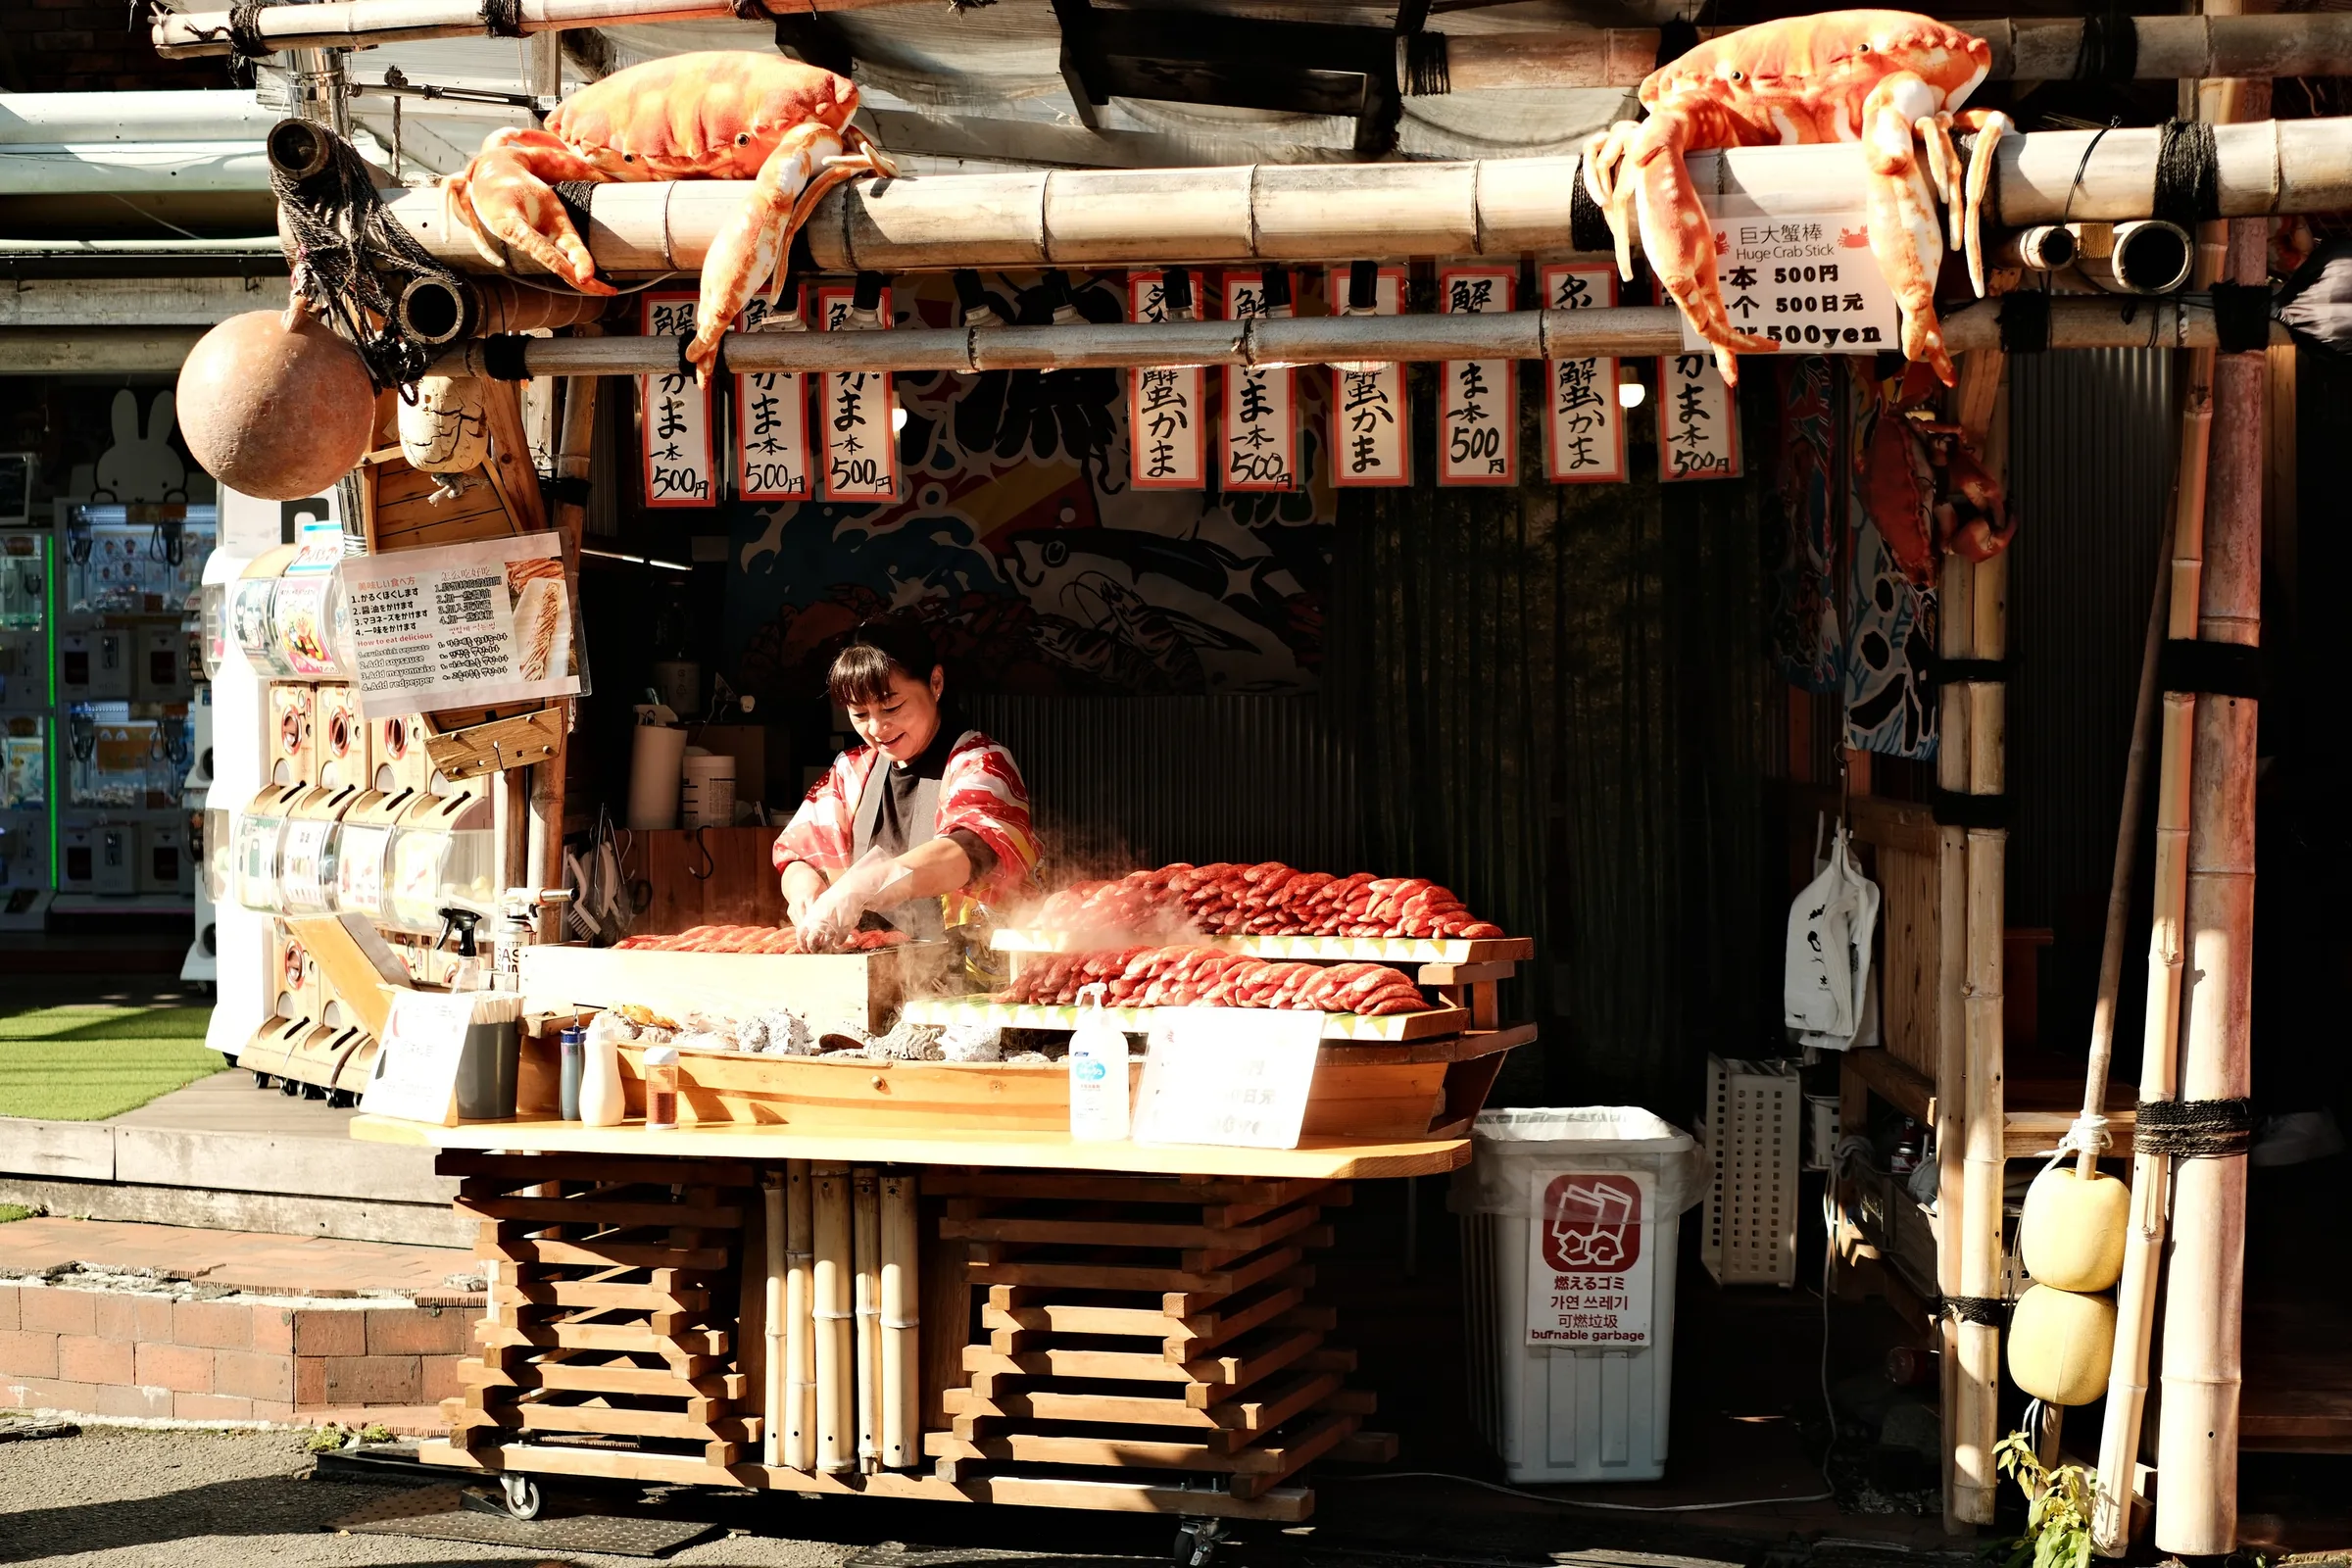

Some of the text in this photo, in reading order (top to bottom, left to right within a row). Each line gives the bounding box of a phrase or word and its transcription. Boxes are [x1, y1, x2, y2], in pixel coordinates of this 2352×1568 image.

[1740, 222, 1824, 244] 巨大蟹棒
[1736, 243, 1835, 263] Huge Crab Stick
[1774, 264, 1838, 284] 500円
[1725, 293, 1864, 319] 个 500日元
[1767, 324, 1882, 348] 500yen
[1446, 402, 1490, 424] 一本
[745, 434, 788, 456] 一本
[829, 434, 864, 456] 一本
[1230, 424, 1275, 450] 一本
[1667, 424, 1709, 449] 一本
[649, 442, 684, 462] 一本
[1449, 425, 1505, 474] 500円
[830, 457, 893, 495] 500円
[1230, 451, 1293, 490] 500円
[1671, 451, 1730, 479] 500円
[653, 466, 710, 500] 500円
[745, 462, 806, 495] 500円
[399, 633, 434, 643] delicious
[359, 655, 425, 669] 2.Add soysauce
[361, 669, 386, 680] 3.Add
[386, 664, 436, 677] mayonnaise
[361, 676, 435, 692] 4.Add redpepper
[1554, 1276, 1625, 1291] 燃えるゴミ
[1550, 1295, 1628, 1310] 가연 쓰레기
[1558, 1314, 1618, 1329] 可燃垃圾
[1532, 1329, 1645, 1342] burnable garbage
